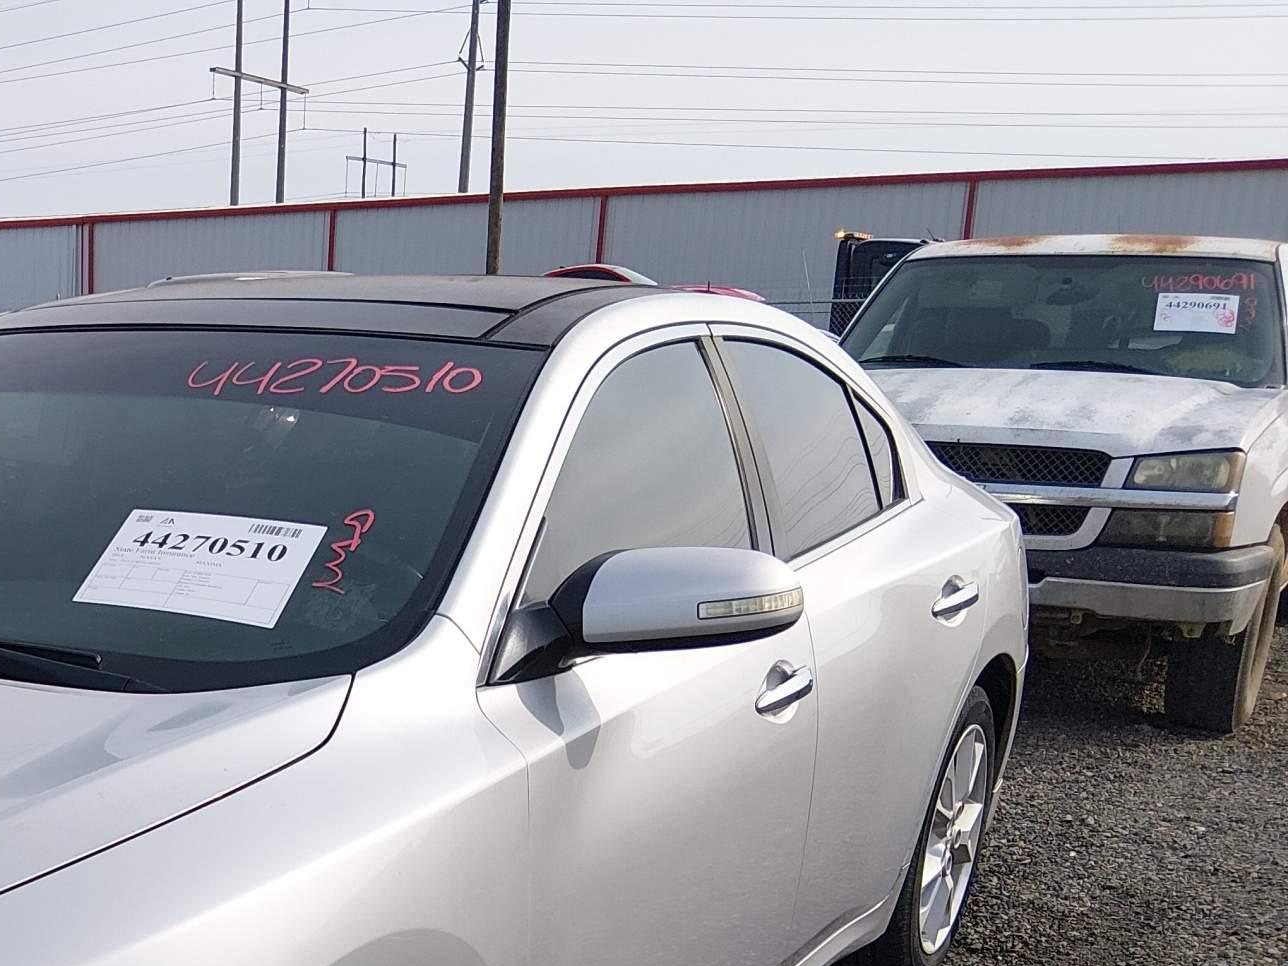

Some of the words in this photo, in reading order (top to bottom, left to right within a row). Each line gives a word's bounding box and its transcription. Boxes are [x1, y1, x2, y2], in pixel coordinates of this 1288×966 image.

[1142, 273, 1256, 293] 44290691
[1165, 301, 1227, 310] 44290691
[187, 358, 482, 396] 44270510
[132, 530, 289, 562] 44270510
